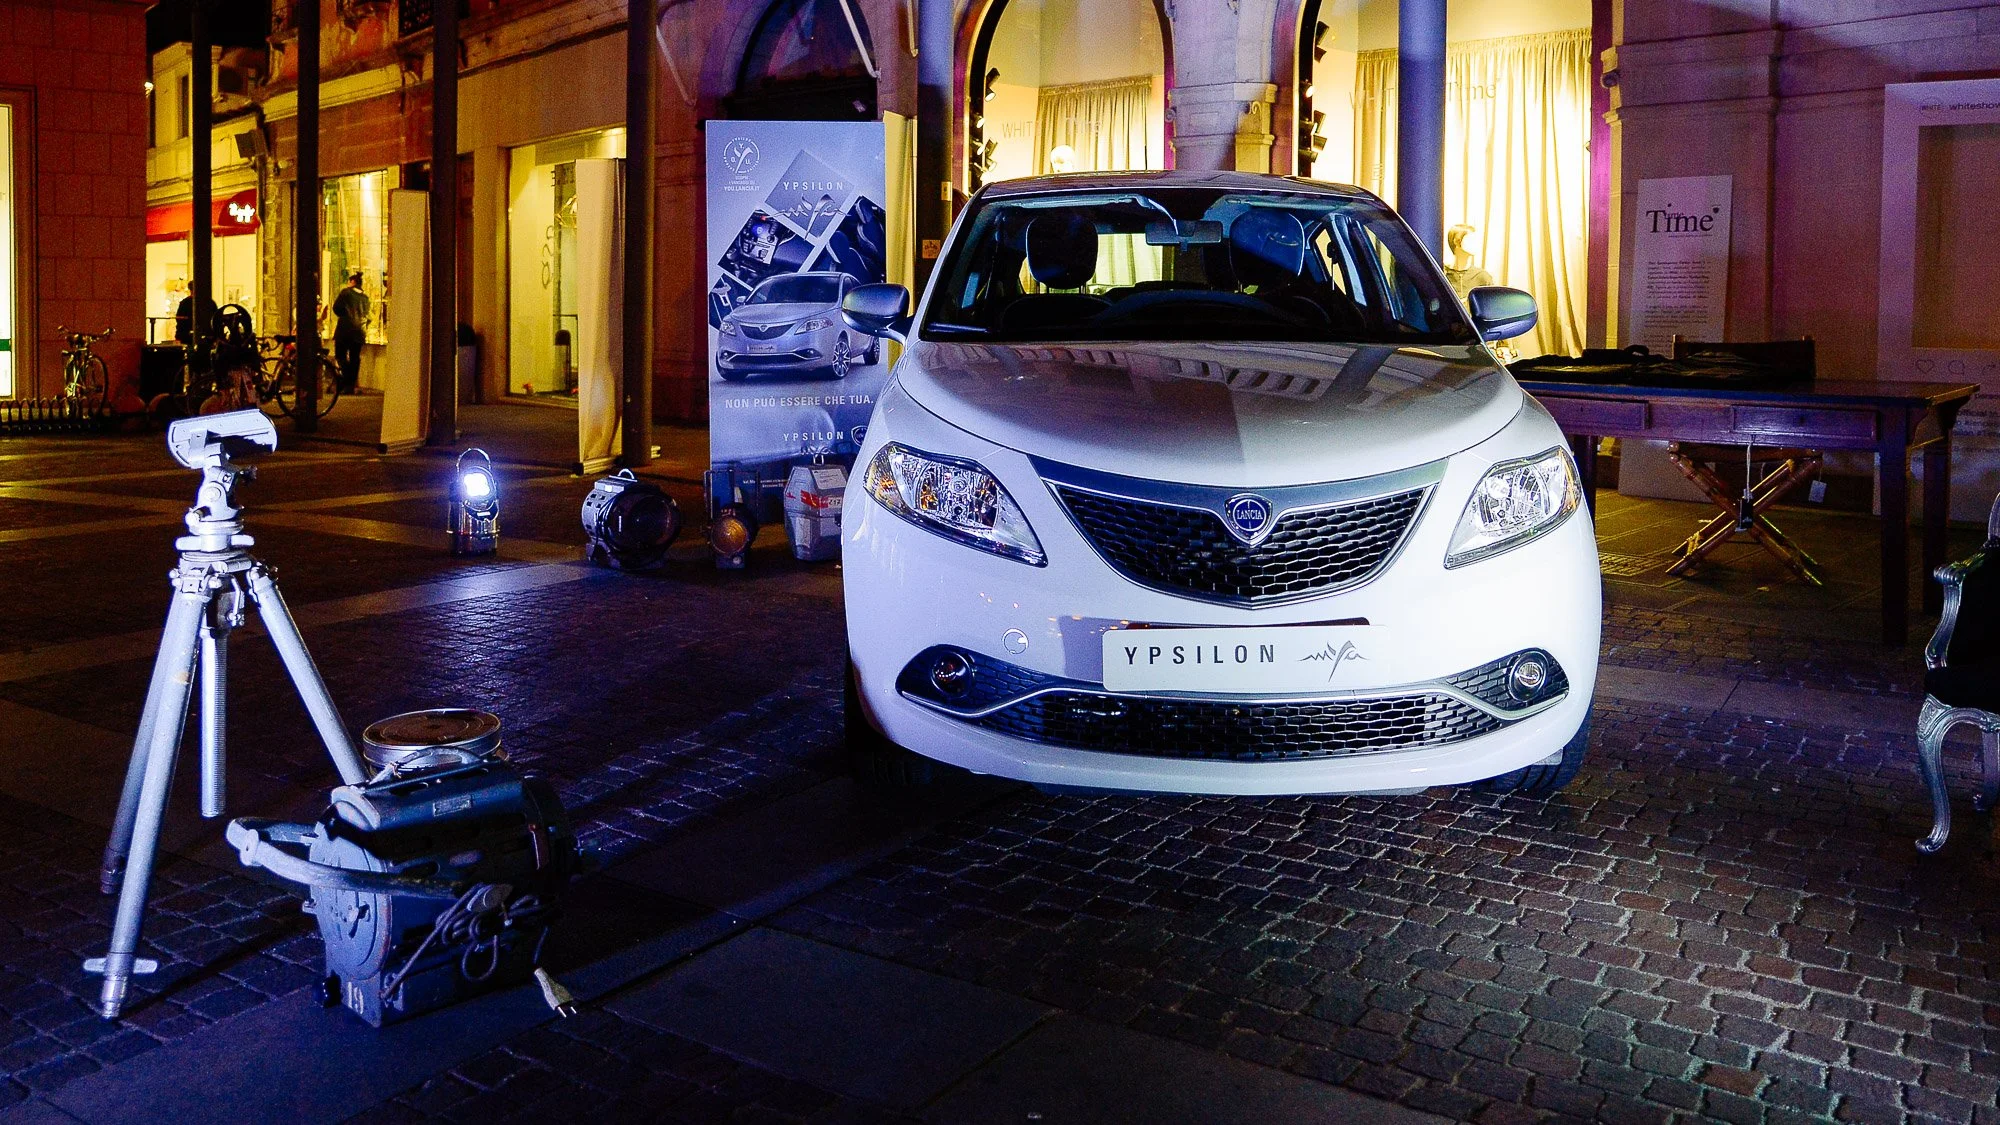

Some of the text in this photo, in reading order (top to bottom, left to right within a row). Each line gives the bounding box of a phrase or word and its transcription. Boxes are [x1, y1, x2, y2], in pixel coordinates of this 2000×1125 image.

[783, 181, 843, 191] YPSILON
[725, 394, 874, 409] NON PUÒ ESSERE CHE TUA.
[783, 431, 844, 441] YPSILON
[1236, 509, 1263, 520] LANCIA
[1124, 644, 1275, 666] YPSILON
